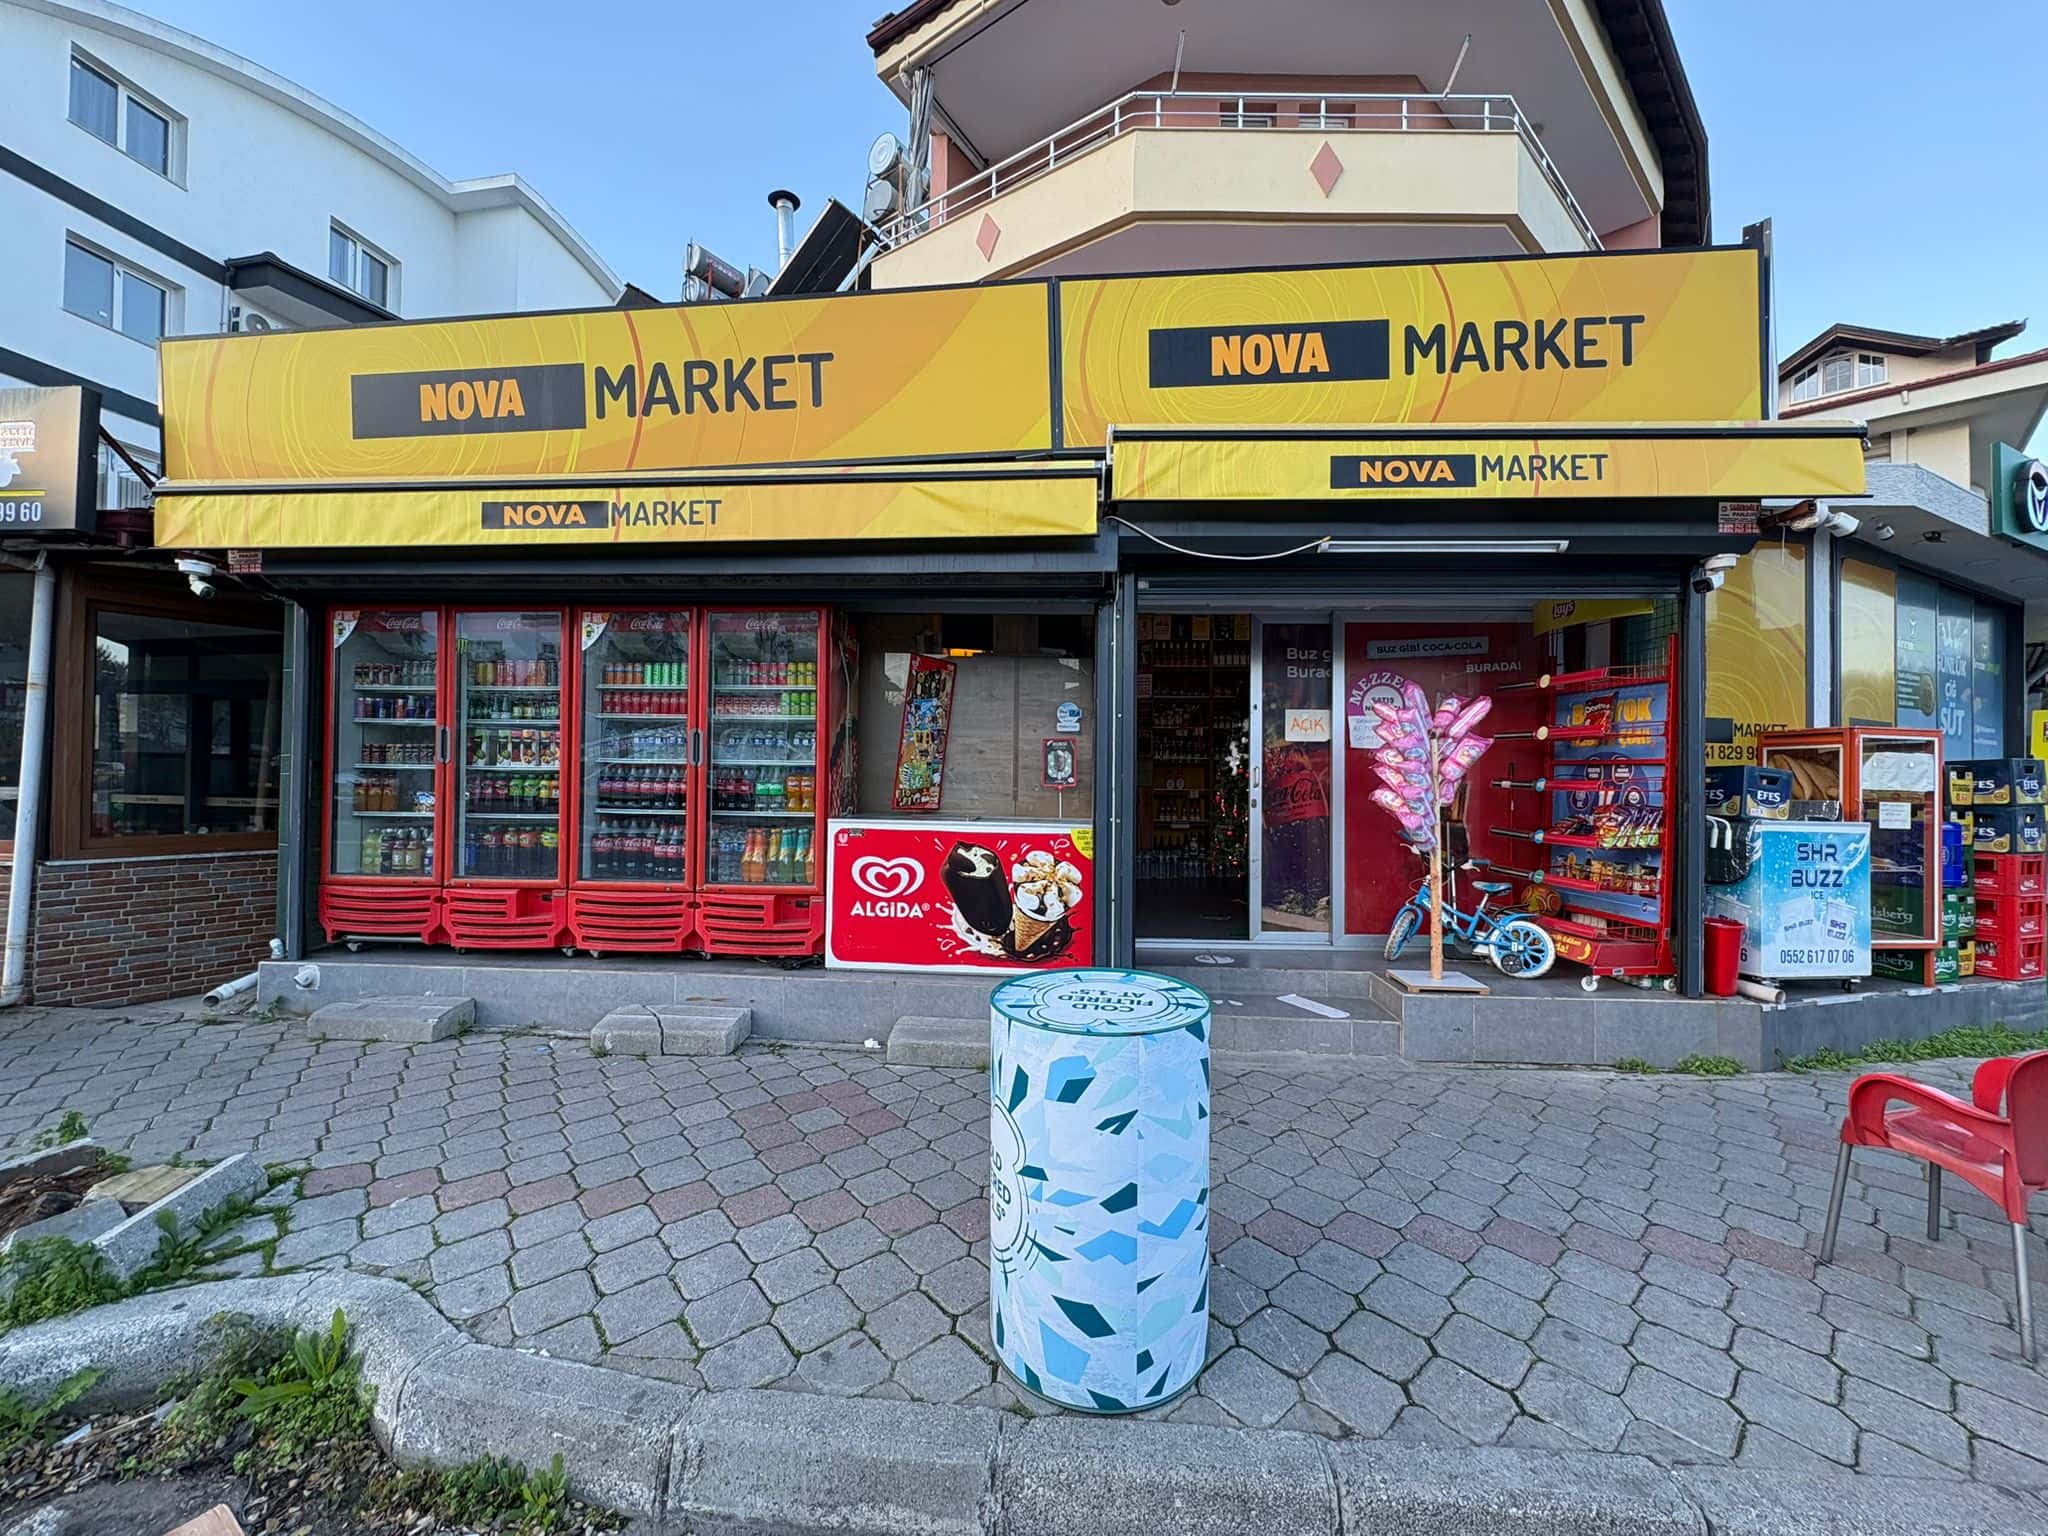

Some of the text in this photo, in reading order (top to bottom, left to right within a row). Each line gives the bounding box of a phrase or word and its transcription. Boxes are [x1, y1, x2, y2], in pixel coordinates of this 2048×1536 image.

[1210, 315, 1645, 377] NOVA MARKET
[420, 352, 834, 422] NOVA MARKET
[1359, 453, 1608, 483] NOVA MARKET
[20, 502, 41, 521] 60
[503, 499, 722, 526] NOVA MARKET
[1287, 648, 1318, 660] Buz
[1376, 645, 1398, 654] BUZ
[1422, 641, 1483, 652] COCA-COLA
[1350, 672, 1406, 706] MEZZE
[1718, 745, 1743, 760] 829
[1705, 789, 1724, 800] FES
[1757, 790, 1781, 802] EFES
[1797, 843, 1838, 862] SHR
[1791, 869, 1844, 888] BUZZ
[1810, 890, 1825, 900] ICE
[1872, 905, 1912, 924] lsberg
[1780, 950, 1855, 964] 0552 617 07 06
[1057, 994, 1153, 1006] FILTERED
[1072, 1003, 1134, 1013] COLD
